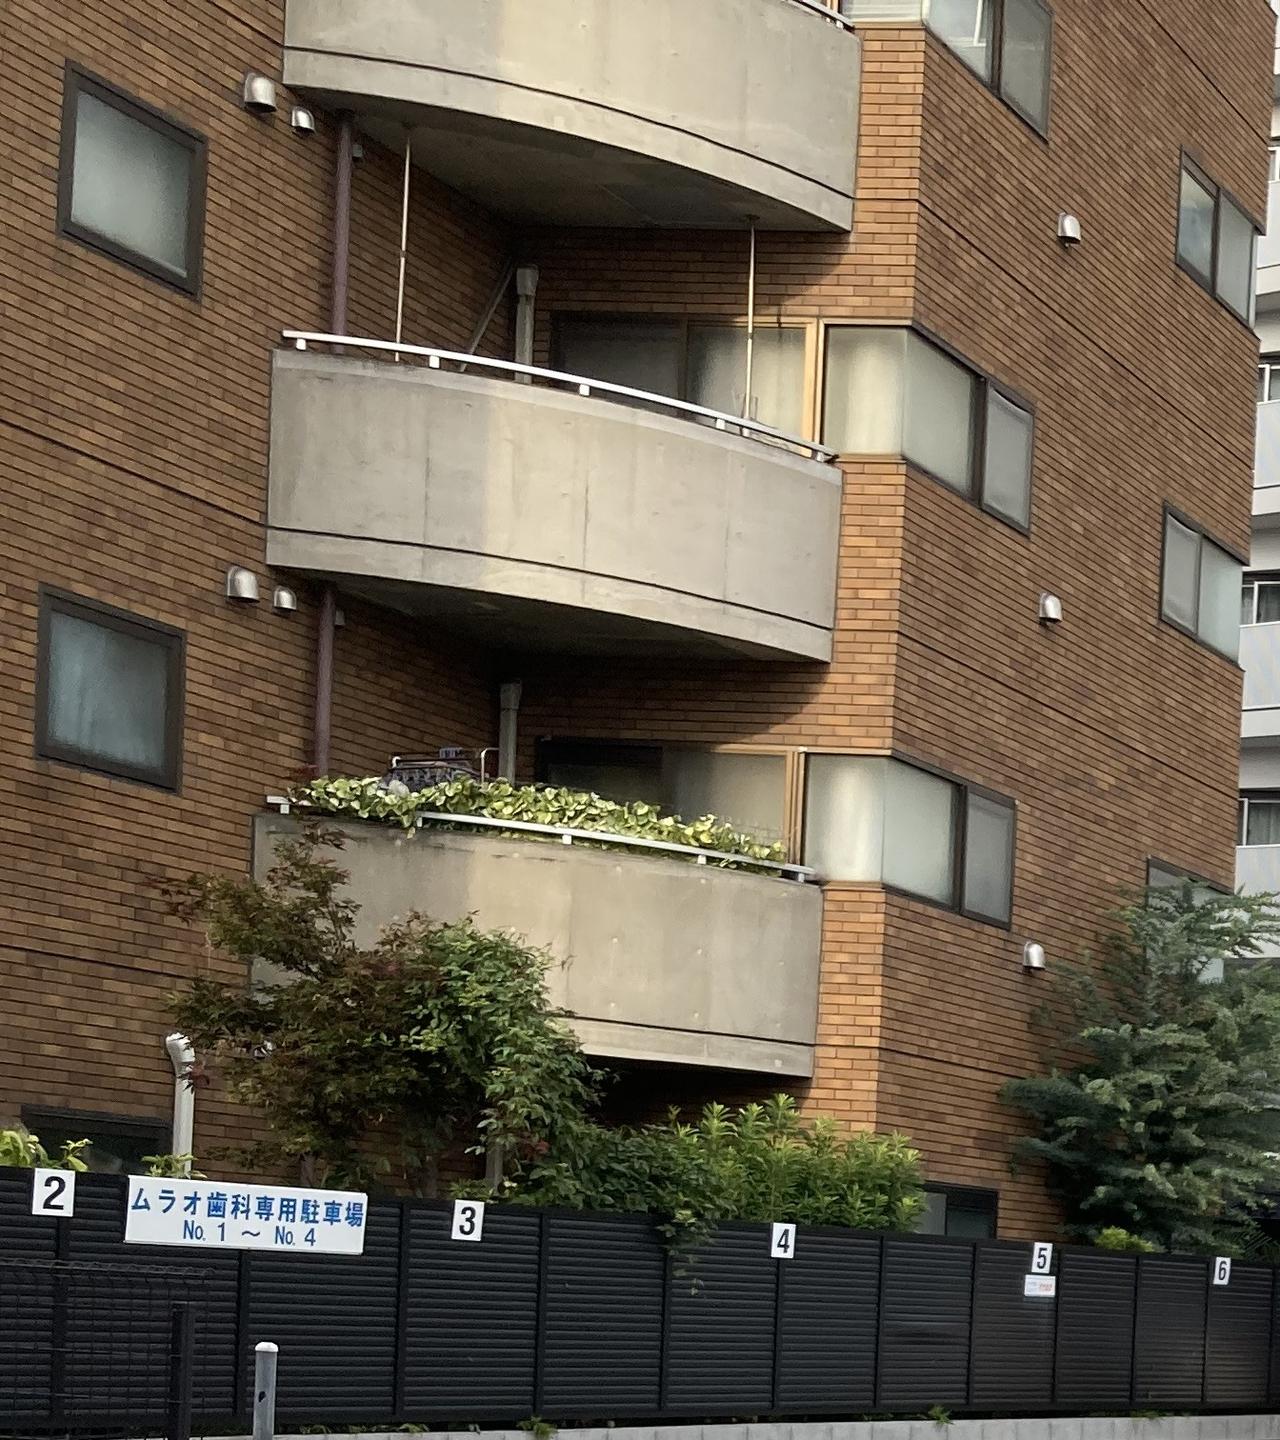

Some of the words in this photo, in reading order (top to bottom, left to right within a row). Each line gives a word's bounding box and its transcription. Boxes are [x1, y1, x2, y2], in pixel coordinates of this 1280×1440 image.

[41, 1174, 67, 1211] 2
[130, 1186, 365, 1228] ムラオ歯科専用駐車場
[457, 1205, 477, 1237] 3
[776, 1227, 791, 1255] 4
[1036, 1247, 1048, 1270] 5
[1217, 1260, 1228, 1281] 6
